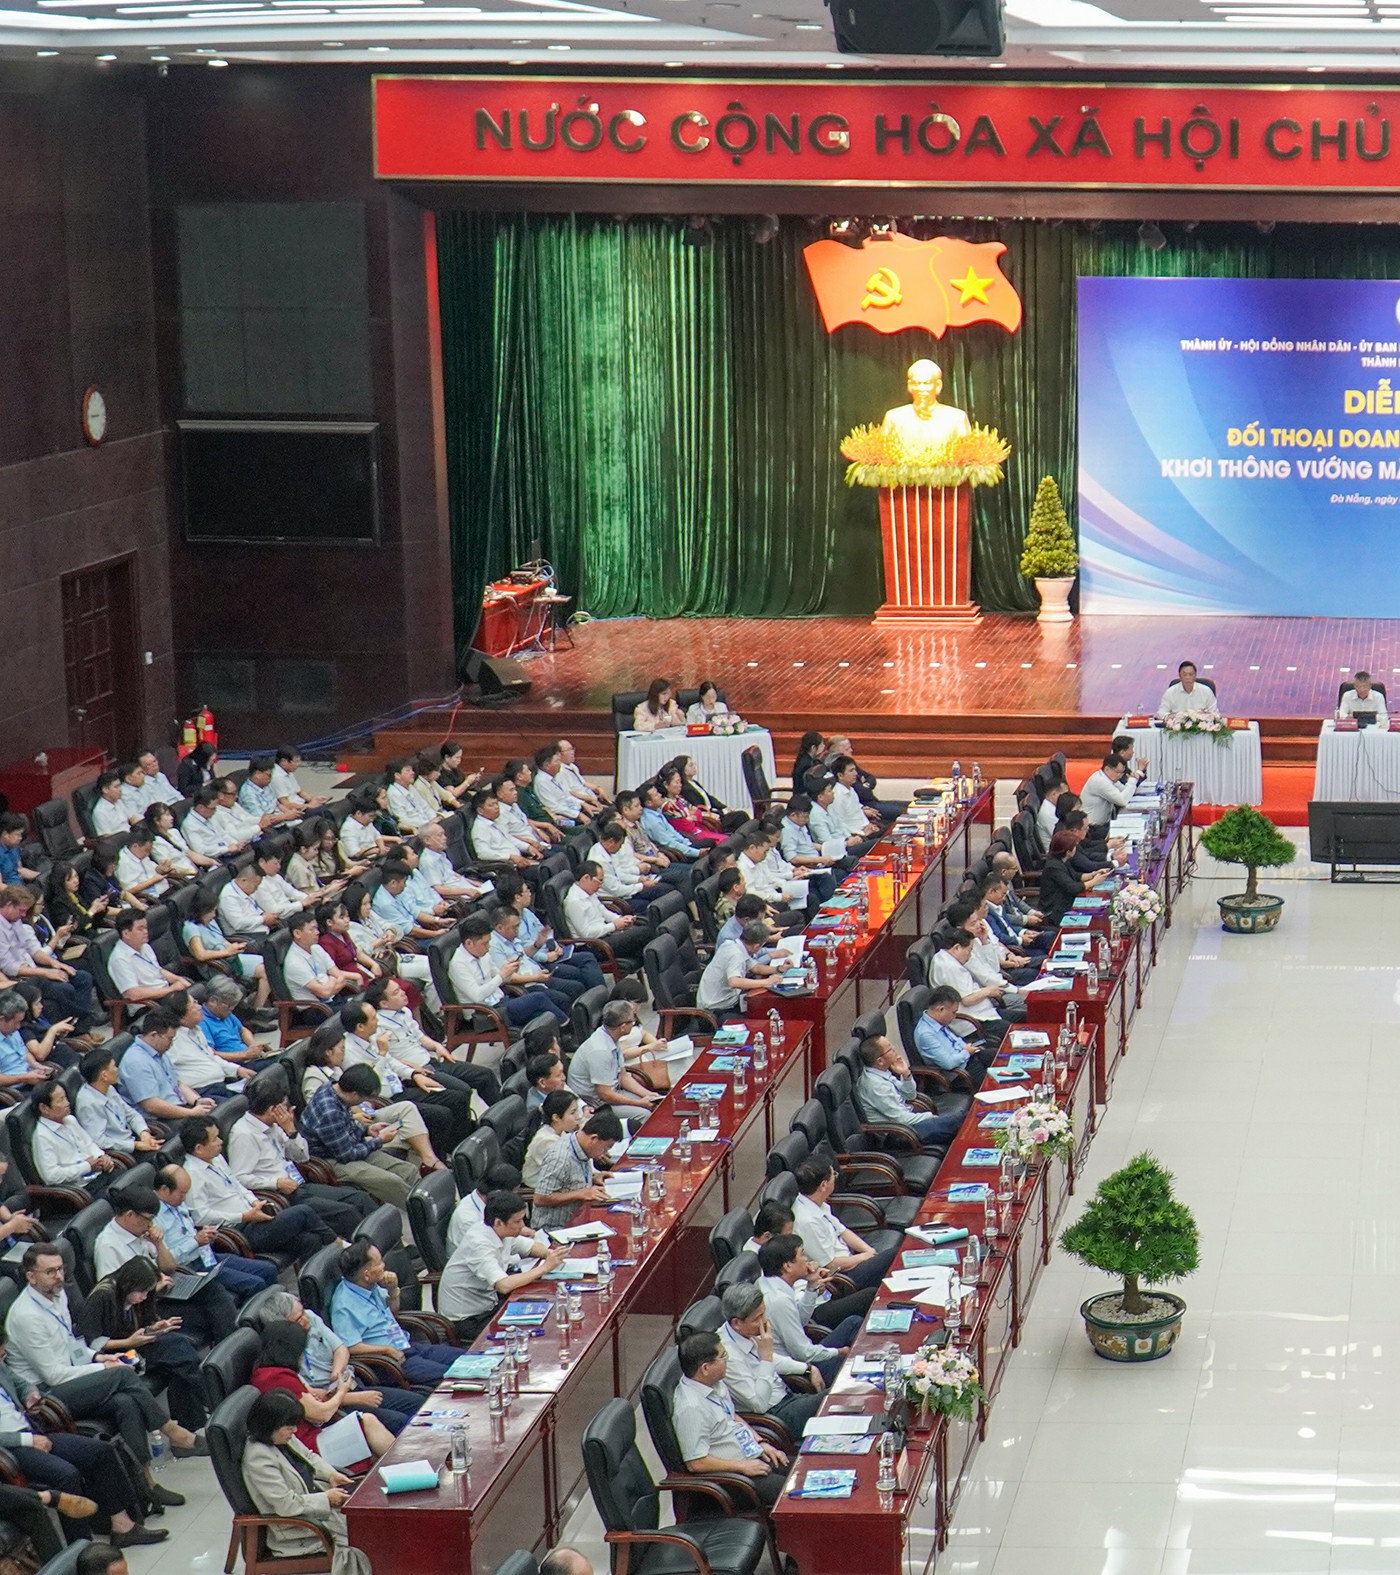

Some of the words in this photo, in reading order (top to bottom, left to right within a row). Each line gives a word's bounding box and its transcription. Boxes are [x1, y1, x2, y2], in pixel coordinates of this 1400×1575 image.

[475, 94, 648, 153] NƯỚC
[670, 99, 850, 167] CỘNG
[875, 101, 1007, 156] HÒA
[1026, 105, 1112, 157] XÃ
[1134, 103, 1240, 171] HỘI
[1264, 102, 1391, 161] CHỦ
[1180, 338, 1216, 351] THÀNH
[1218, 337, 1232, 351] ỦY
[1240, 339, 1259, 353] HỘI
[1262, 337, 1294, 352] ĐỒNG
[1296, 339, 1326, 352] NHÂN
[1329, 339, 1351, 352] DÂN
[1359, 339, 1373, 353] ỦY
[1375, 342, 1397, 353] BAN
[1361, 355, 1397, 368] THÀNH
[1227, 420, 1265, 447] ĐỐI
[1271, 428, 1333, 452] THOẠI
[1161, 457, 1212, 478] KHƠI
[1218, 455, 1291, 479] THÔNG
[1297, 456, 1373, 480] VƯỚNG
[1330, 494, 1343, 503] Đà
[1374, 496, 1398, 506] ngày
